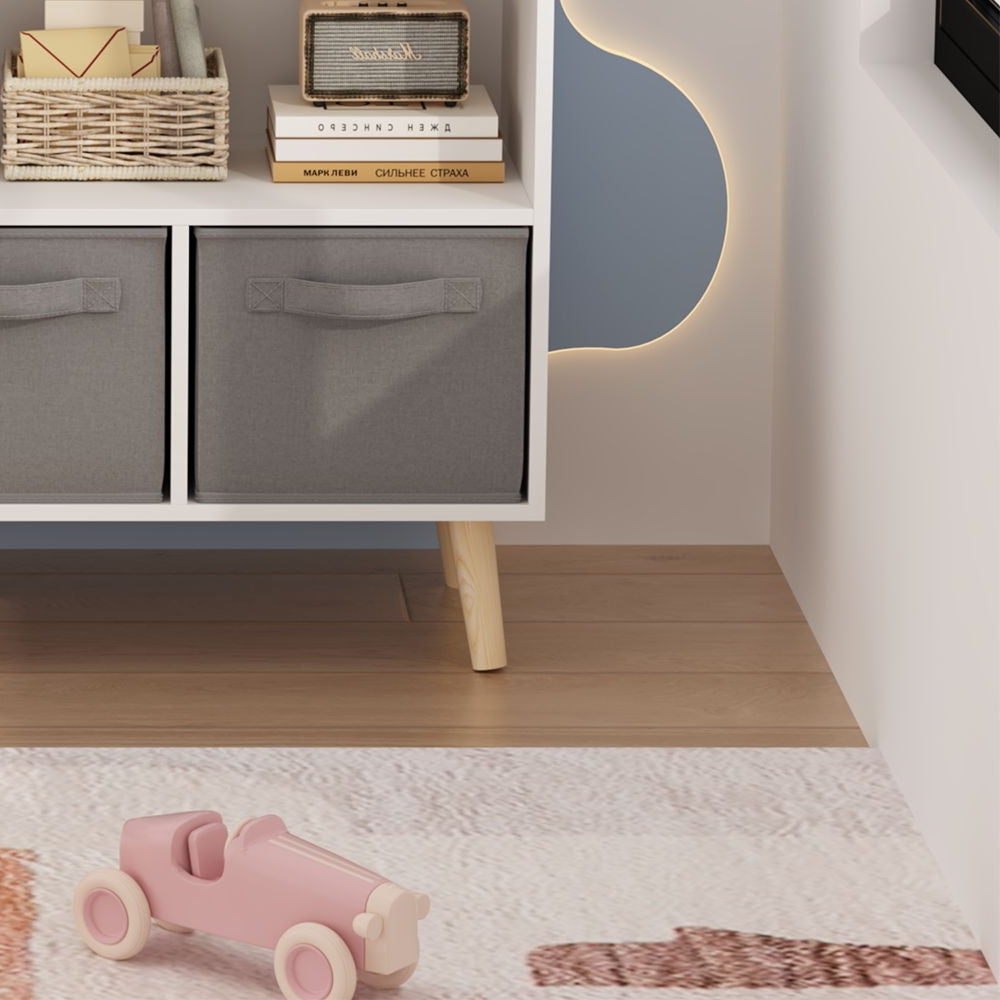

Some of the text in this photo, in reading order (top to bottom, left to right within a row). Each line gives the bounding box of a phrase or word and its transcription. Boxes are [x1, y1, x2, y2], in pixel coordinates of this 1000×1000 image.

[304, 168, 469, 178] МАРК ЛЕВИ СИЛЬНЕЕ СТРАХА
